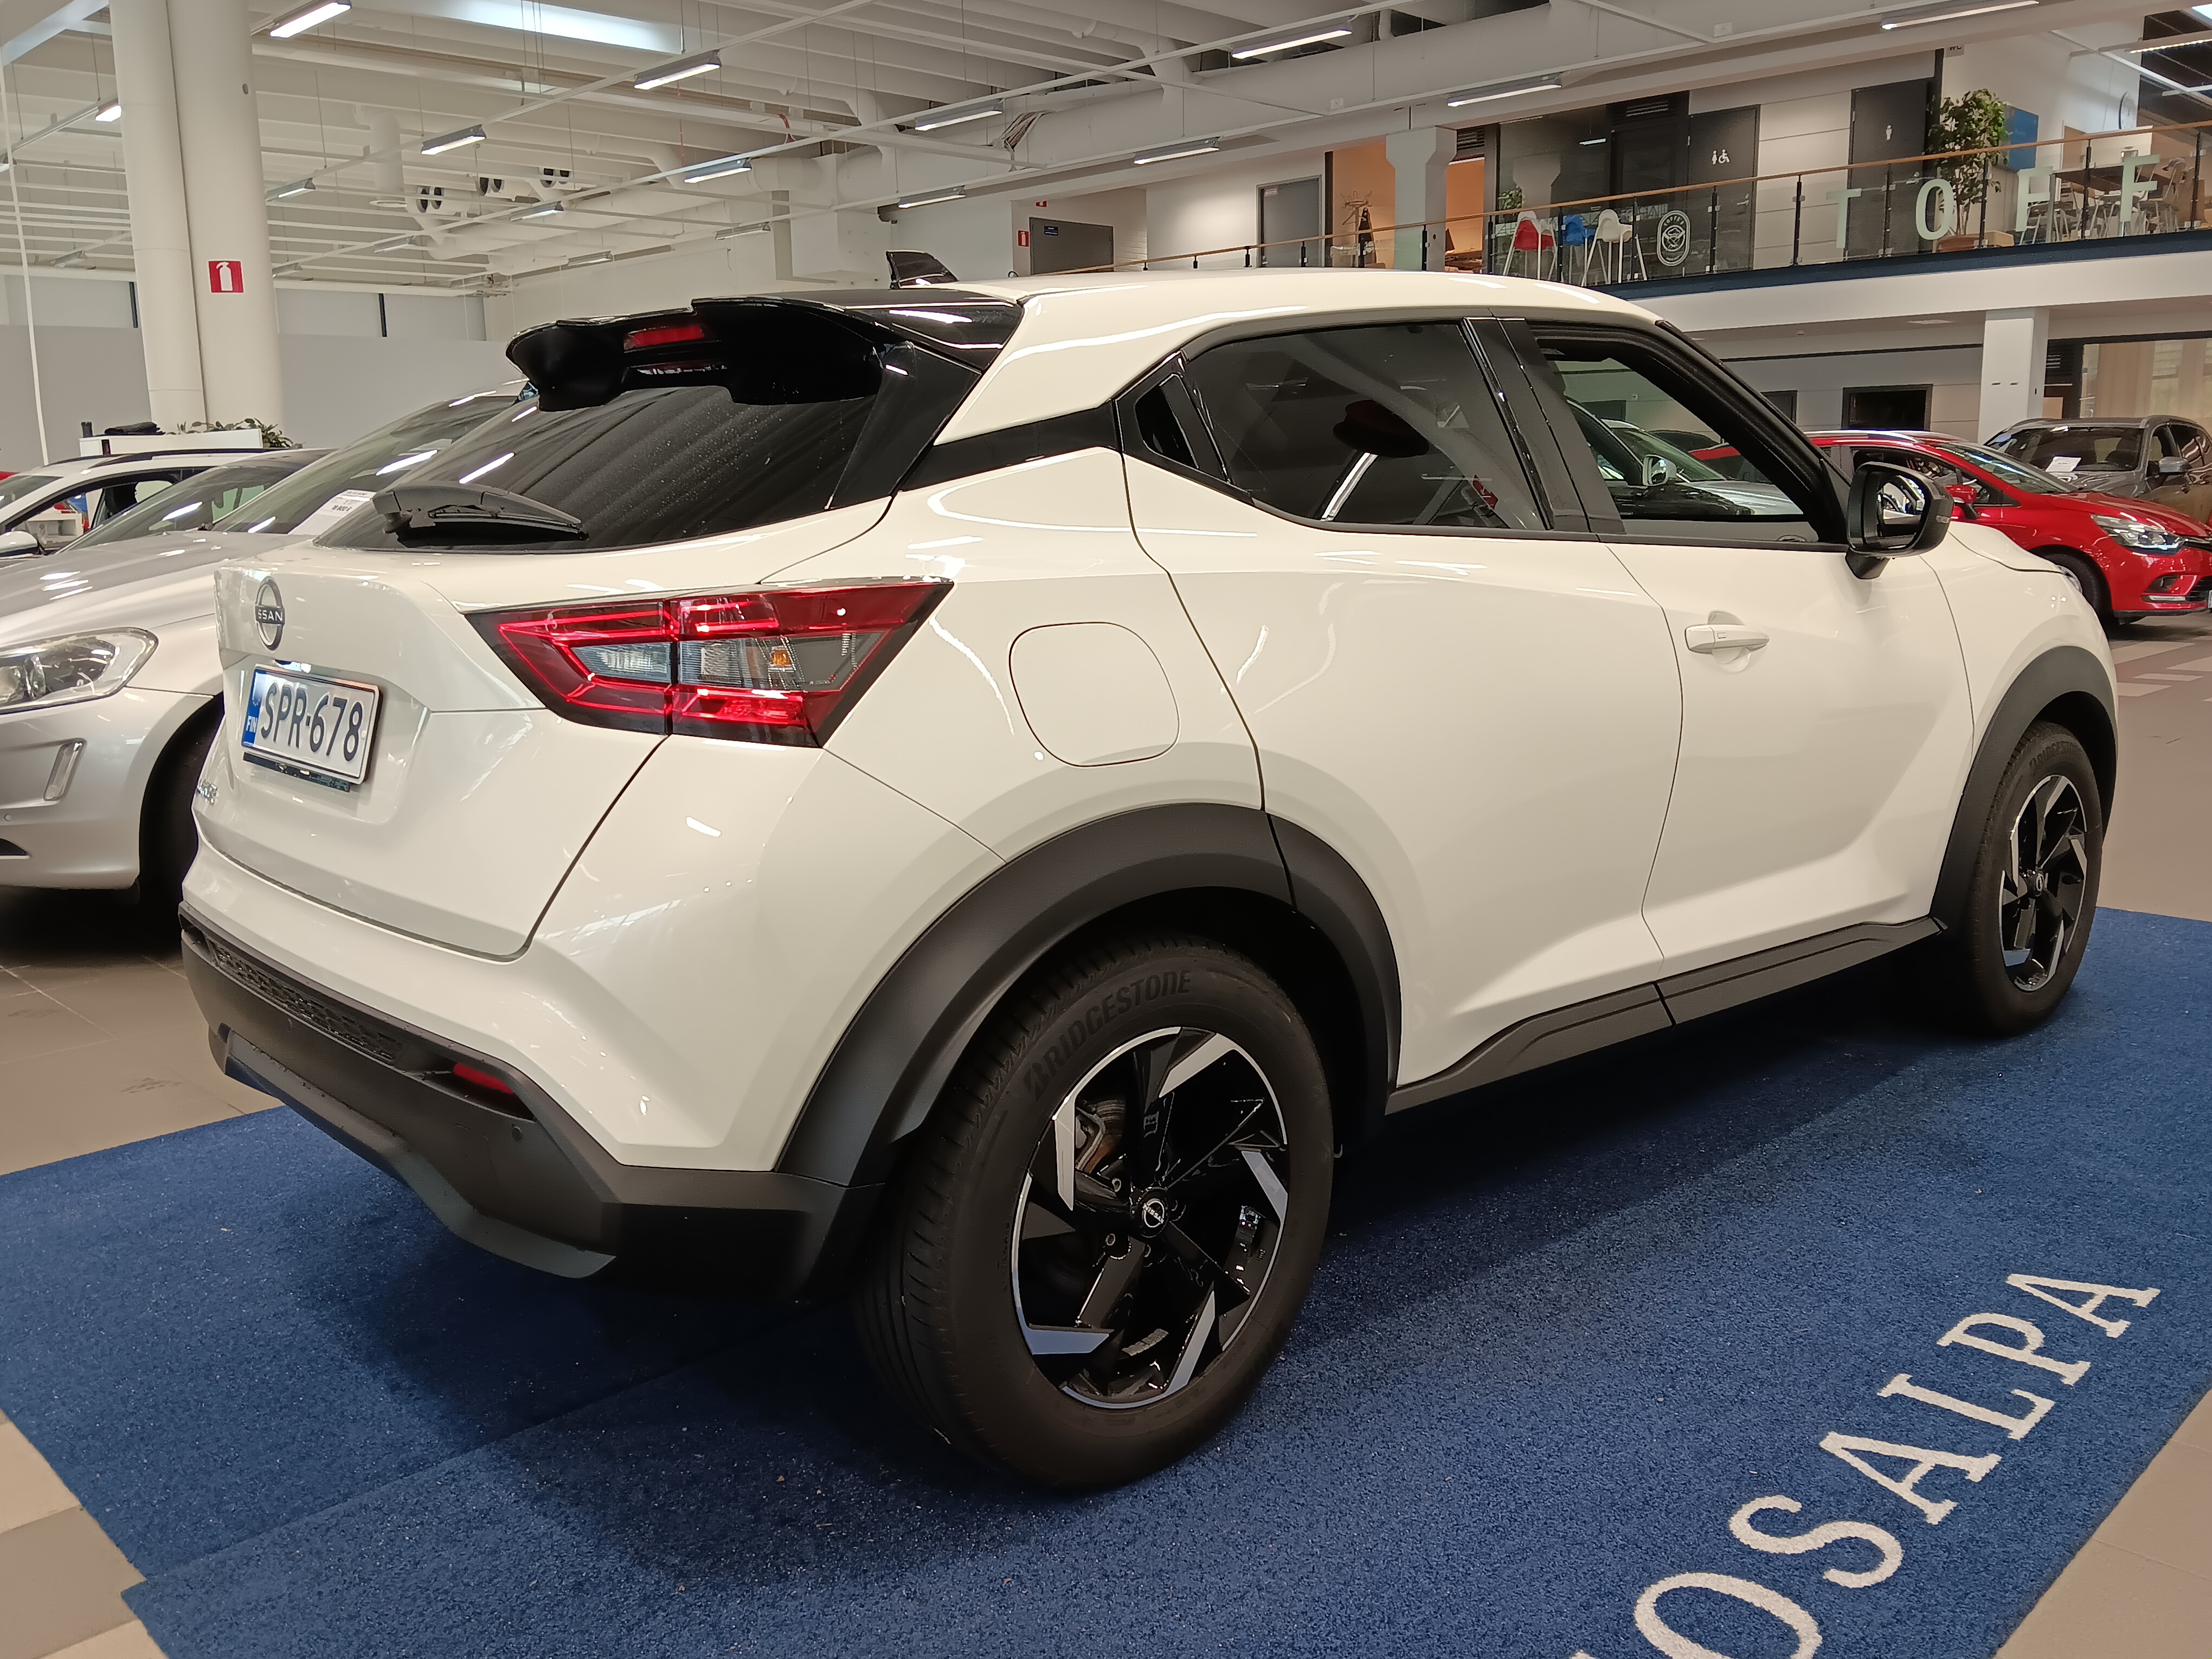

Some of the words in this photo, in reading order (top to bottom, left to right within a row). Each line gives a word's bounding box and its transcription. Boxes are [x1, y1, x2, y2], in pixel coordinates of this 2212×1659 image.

[246, 715, 258, 734] FIN
[261, 682, 362, 761] SPR-678
[1023, 970, 1191, 1102] BRIDGESTONE
[1570, 1274, 2161, 1659] OSALPA
